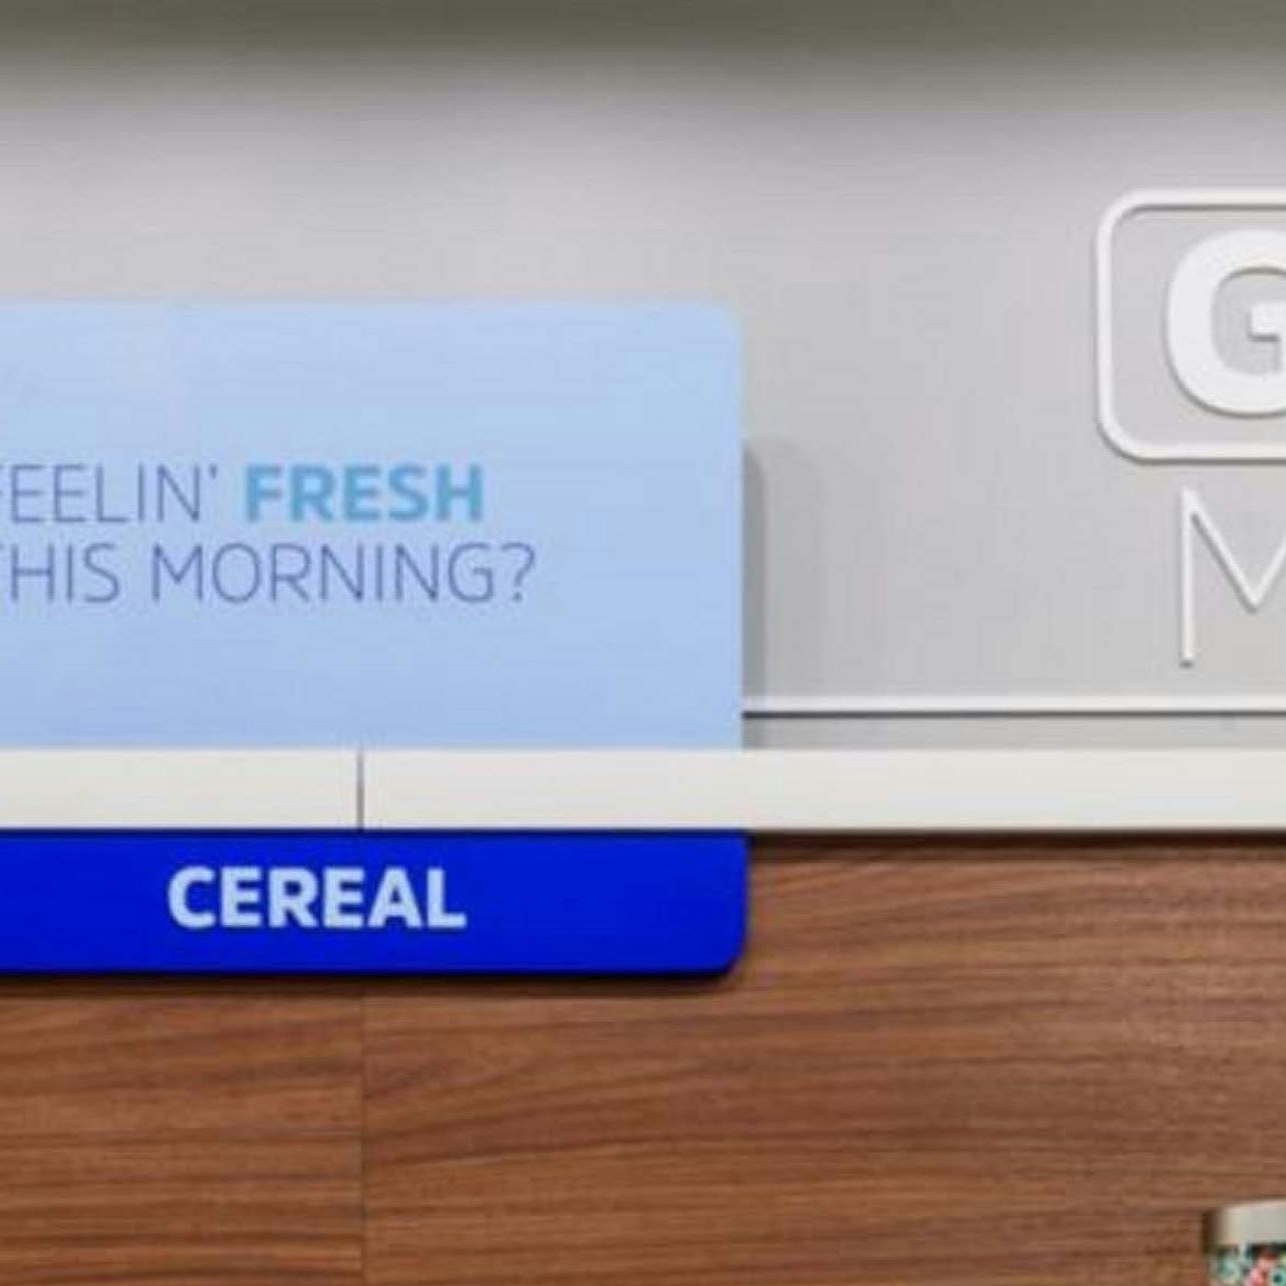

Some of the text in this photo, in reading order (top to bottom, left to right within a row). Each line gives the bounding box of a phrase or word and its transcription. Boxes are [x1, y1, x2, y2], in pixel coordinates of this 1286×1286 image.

[245, 463, 484, 523] FRESH
[151, 543, 537, 604] MORNING?
[168, 866, 467, 929] CEREAL
